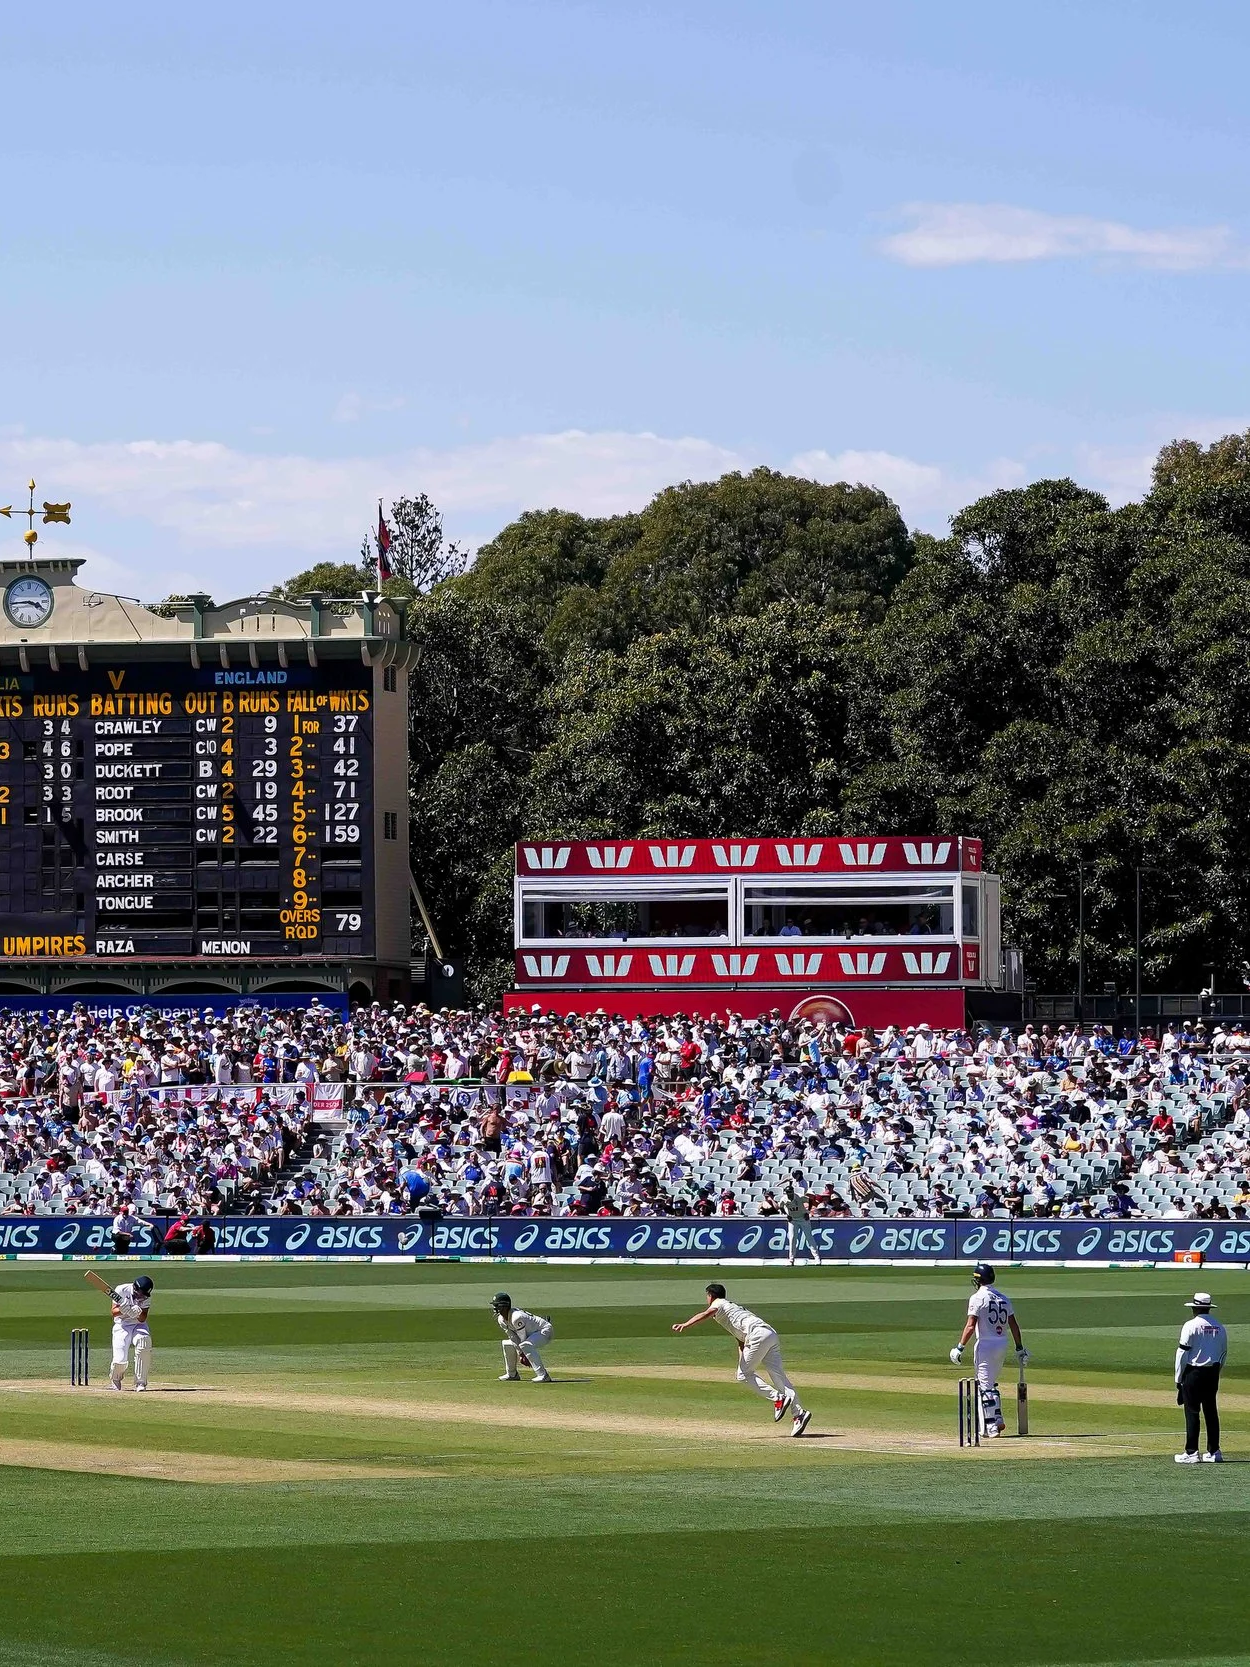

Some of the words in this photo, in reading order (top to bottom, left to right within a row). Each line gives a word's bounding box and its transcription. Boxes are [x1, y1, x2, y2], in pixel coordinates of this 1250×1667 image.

[215, 672, 287, 684] ENGLAND
[34, 694, 79, 716] RUNS
[91, 693, 172, 715] BATTING
[185, 692, 217, 713] OUT
[239, 691, 279, 713] RUNS
[287, 690, 317, 712] FALL
[317, 695, 328, 706] OF
[329, 690, 370, 712] WKTS
[95, 721, 162, 734] CRAWLEY
[303, 721, 319, 733] FOR
[334, 715, 358, 733] 37
[95, 744, 132, 756] POPE
[334, 737, 354, 754] 41
[96, 764, 162, 778] DUCKETT
[252, 760, 277, 777] 29
[334, 759, 359, 776] 42
[96, 787, 133, 800] ROOT
[256, 782, 277, 799] 19
[334, 781, 355, 798] 71
[96, 808, 143, 821] BROOK
[252, 805, 278, 820] 45
[324, 804, 359, 820] 127
[96, 831, 139, 843] SMITH
[253, 826, 278, 842] 22
[324, 826, 360, 842] 159
[96, 853, 143, 866] CARSE
[96, 875, 153, 888] ARCHER
[96, 896, 153, 909] TONGUE
[280, 910, 320, 922] OVERS
[336, 914, 361, 930] 79
[286, 922, 317, 938] R'QD
[3, 936, 86, 956] UMPIRES
[96, 941, 134, 953] RAZA
[202, 942, 250, 954] MENON
[988, 1301, 1007, 1324] 55
